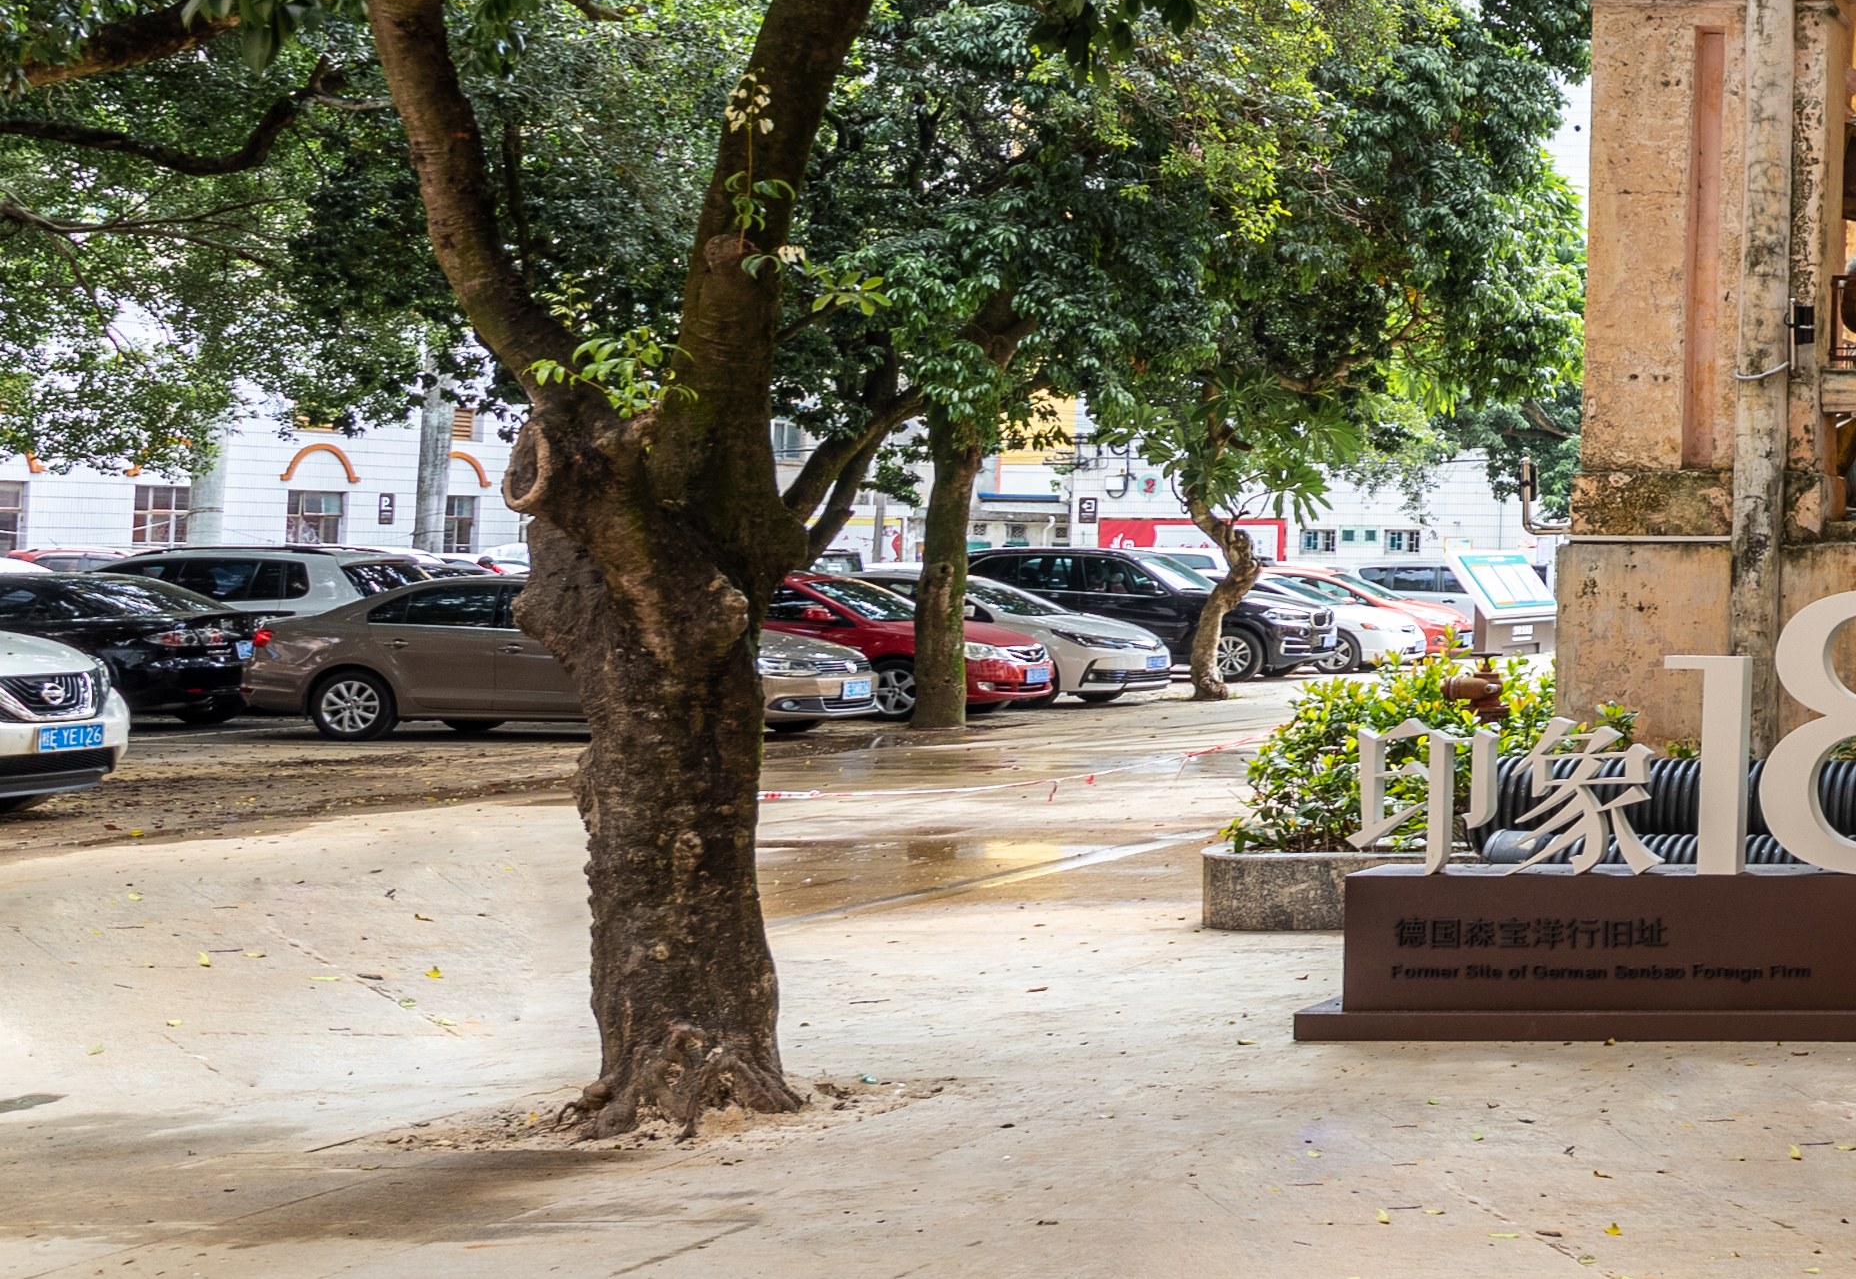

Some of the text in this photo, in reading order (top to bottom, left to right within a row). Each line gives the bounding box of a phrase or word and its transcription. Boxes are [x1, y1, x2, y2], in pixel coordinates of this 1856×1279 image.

[1143, 477, 1157, 494] 2
[1394, 916, 1668, 949] 德国森宝洋行旧址
[1391, 963, 1811, 983] Former Site of German Senbao Foreign Firm
